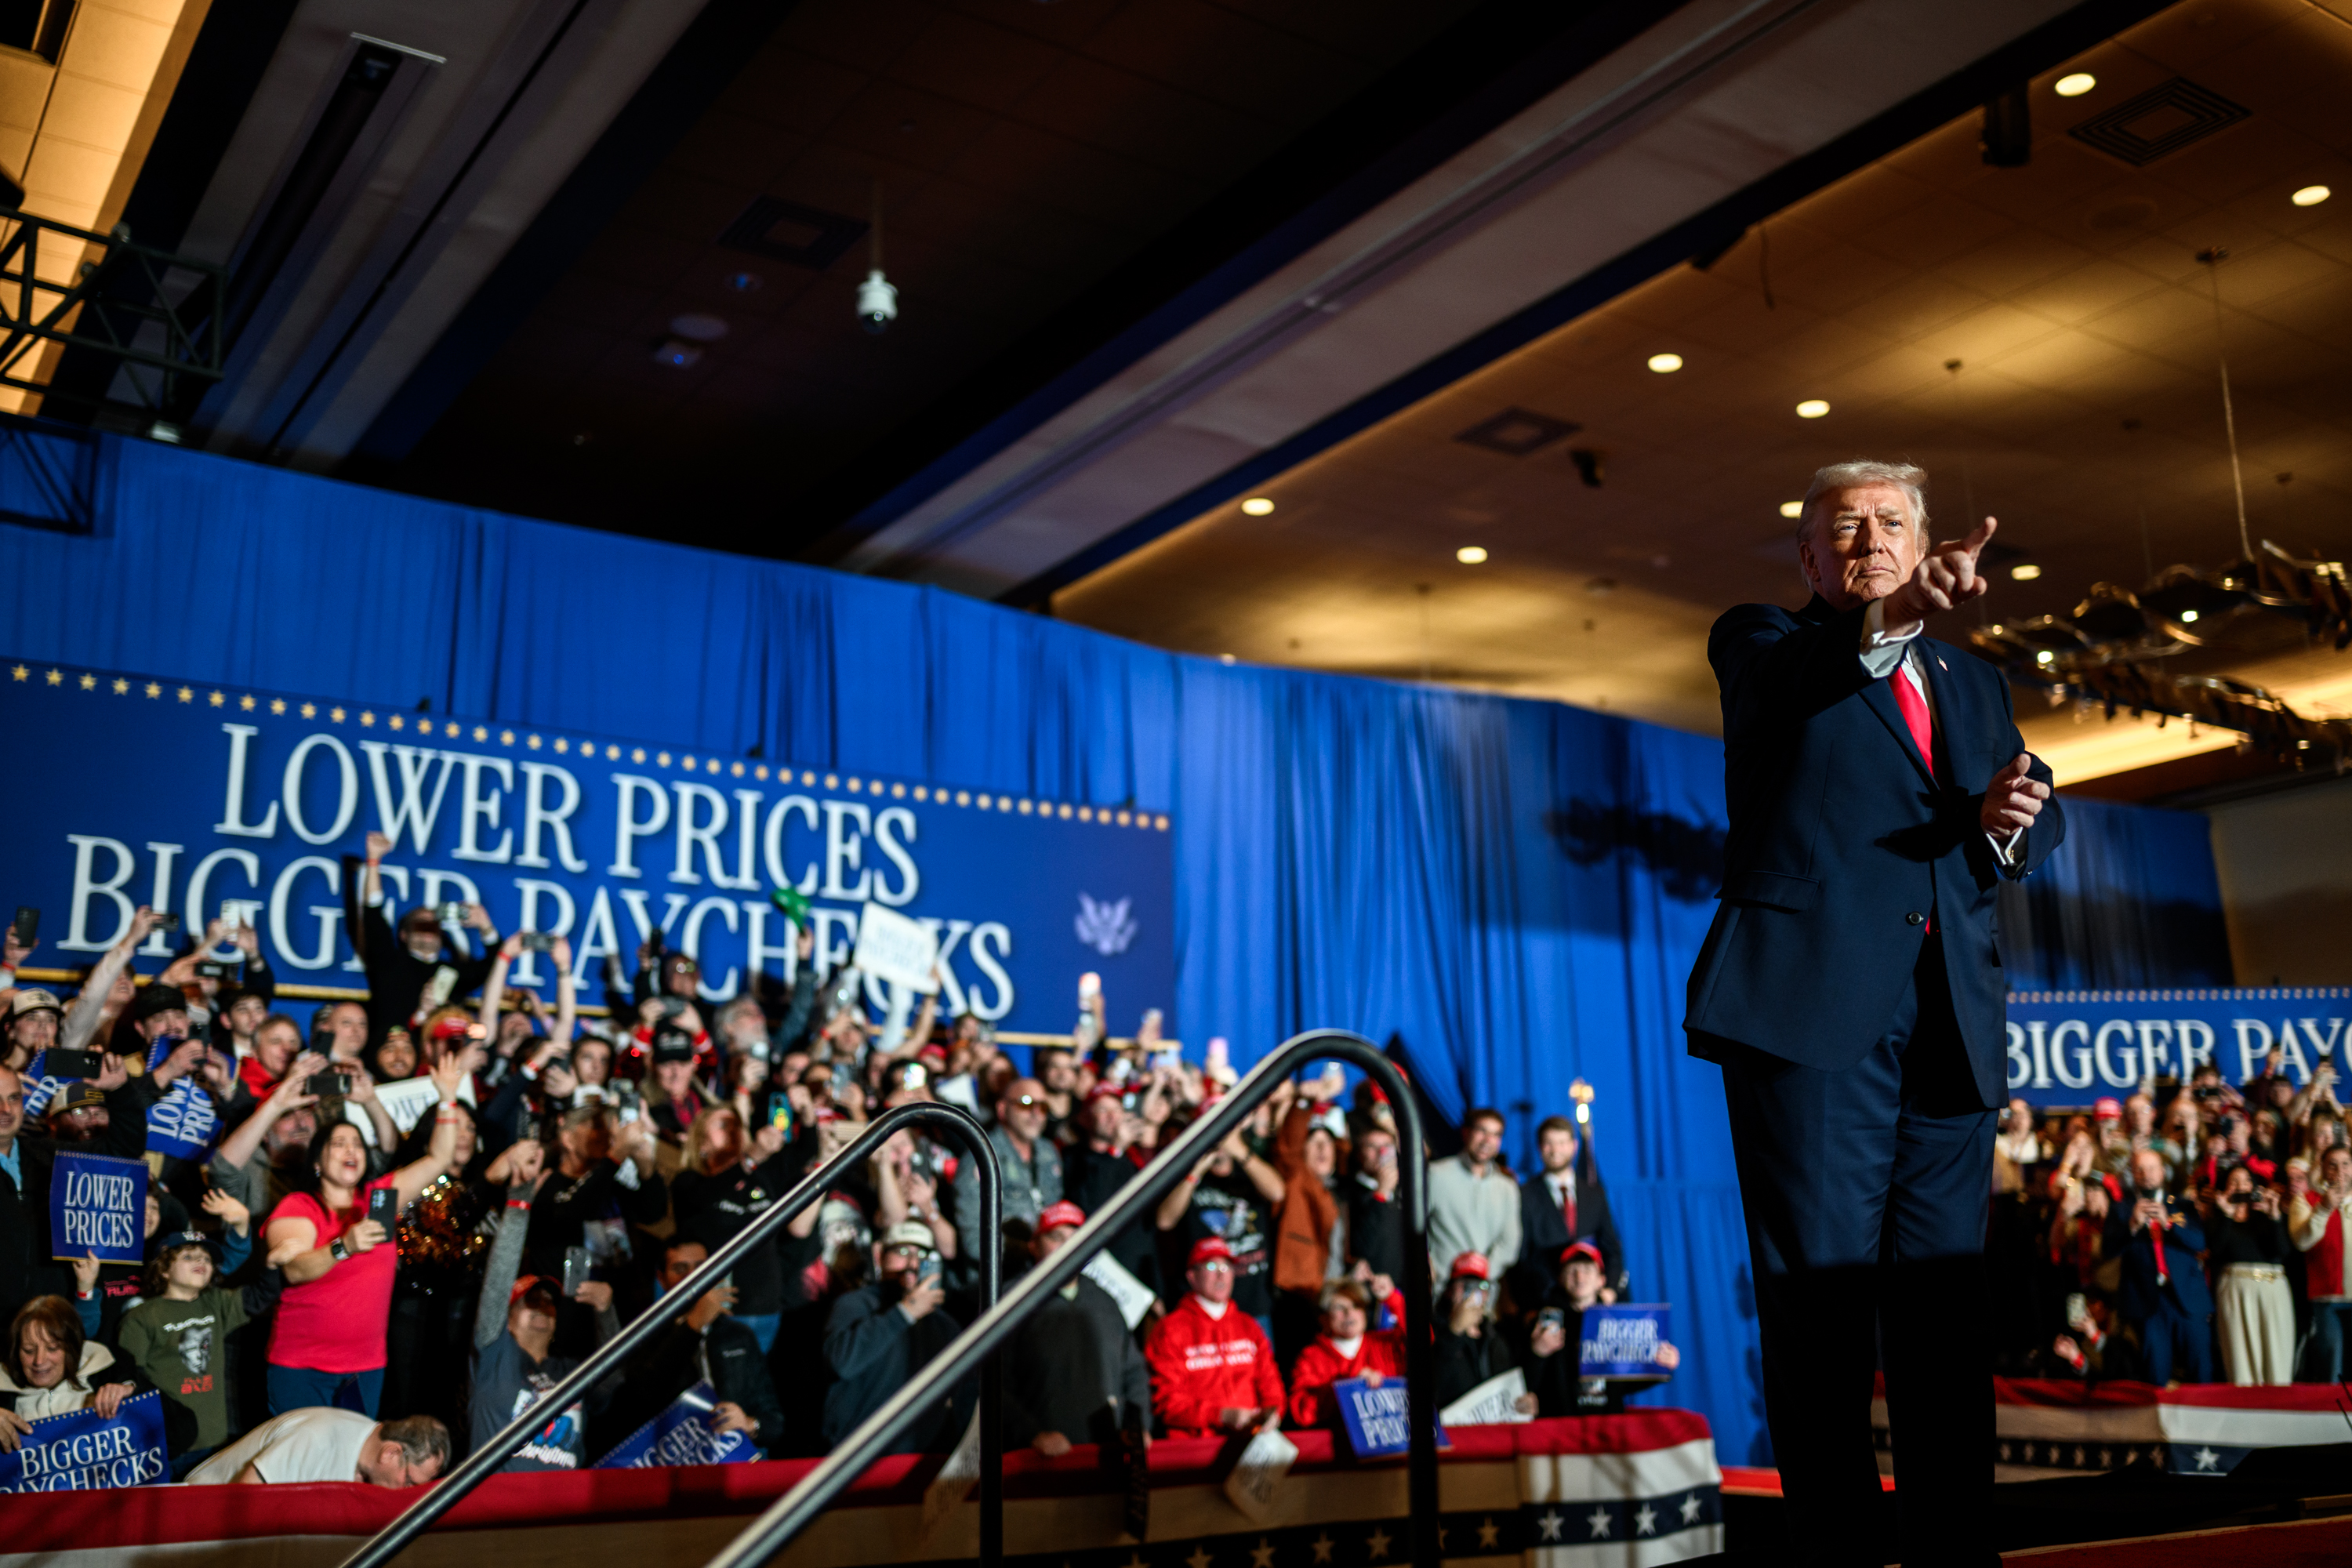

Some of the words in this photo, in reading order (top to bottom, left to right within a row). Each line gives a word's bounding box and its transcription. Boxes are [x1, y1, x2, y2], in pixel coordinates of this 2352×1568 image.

[213, 722, 588, 873] LOWER
[606, 772, 920, 907] PRICES
[179, 1084, 216, 1148] PRIC
[64, 1171, 134, 1212] LOWER
[64, 1208, 134, 1248] PRICES
[18, 1425, 136, 1479] BIGGER
